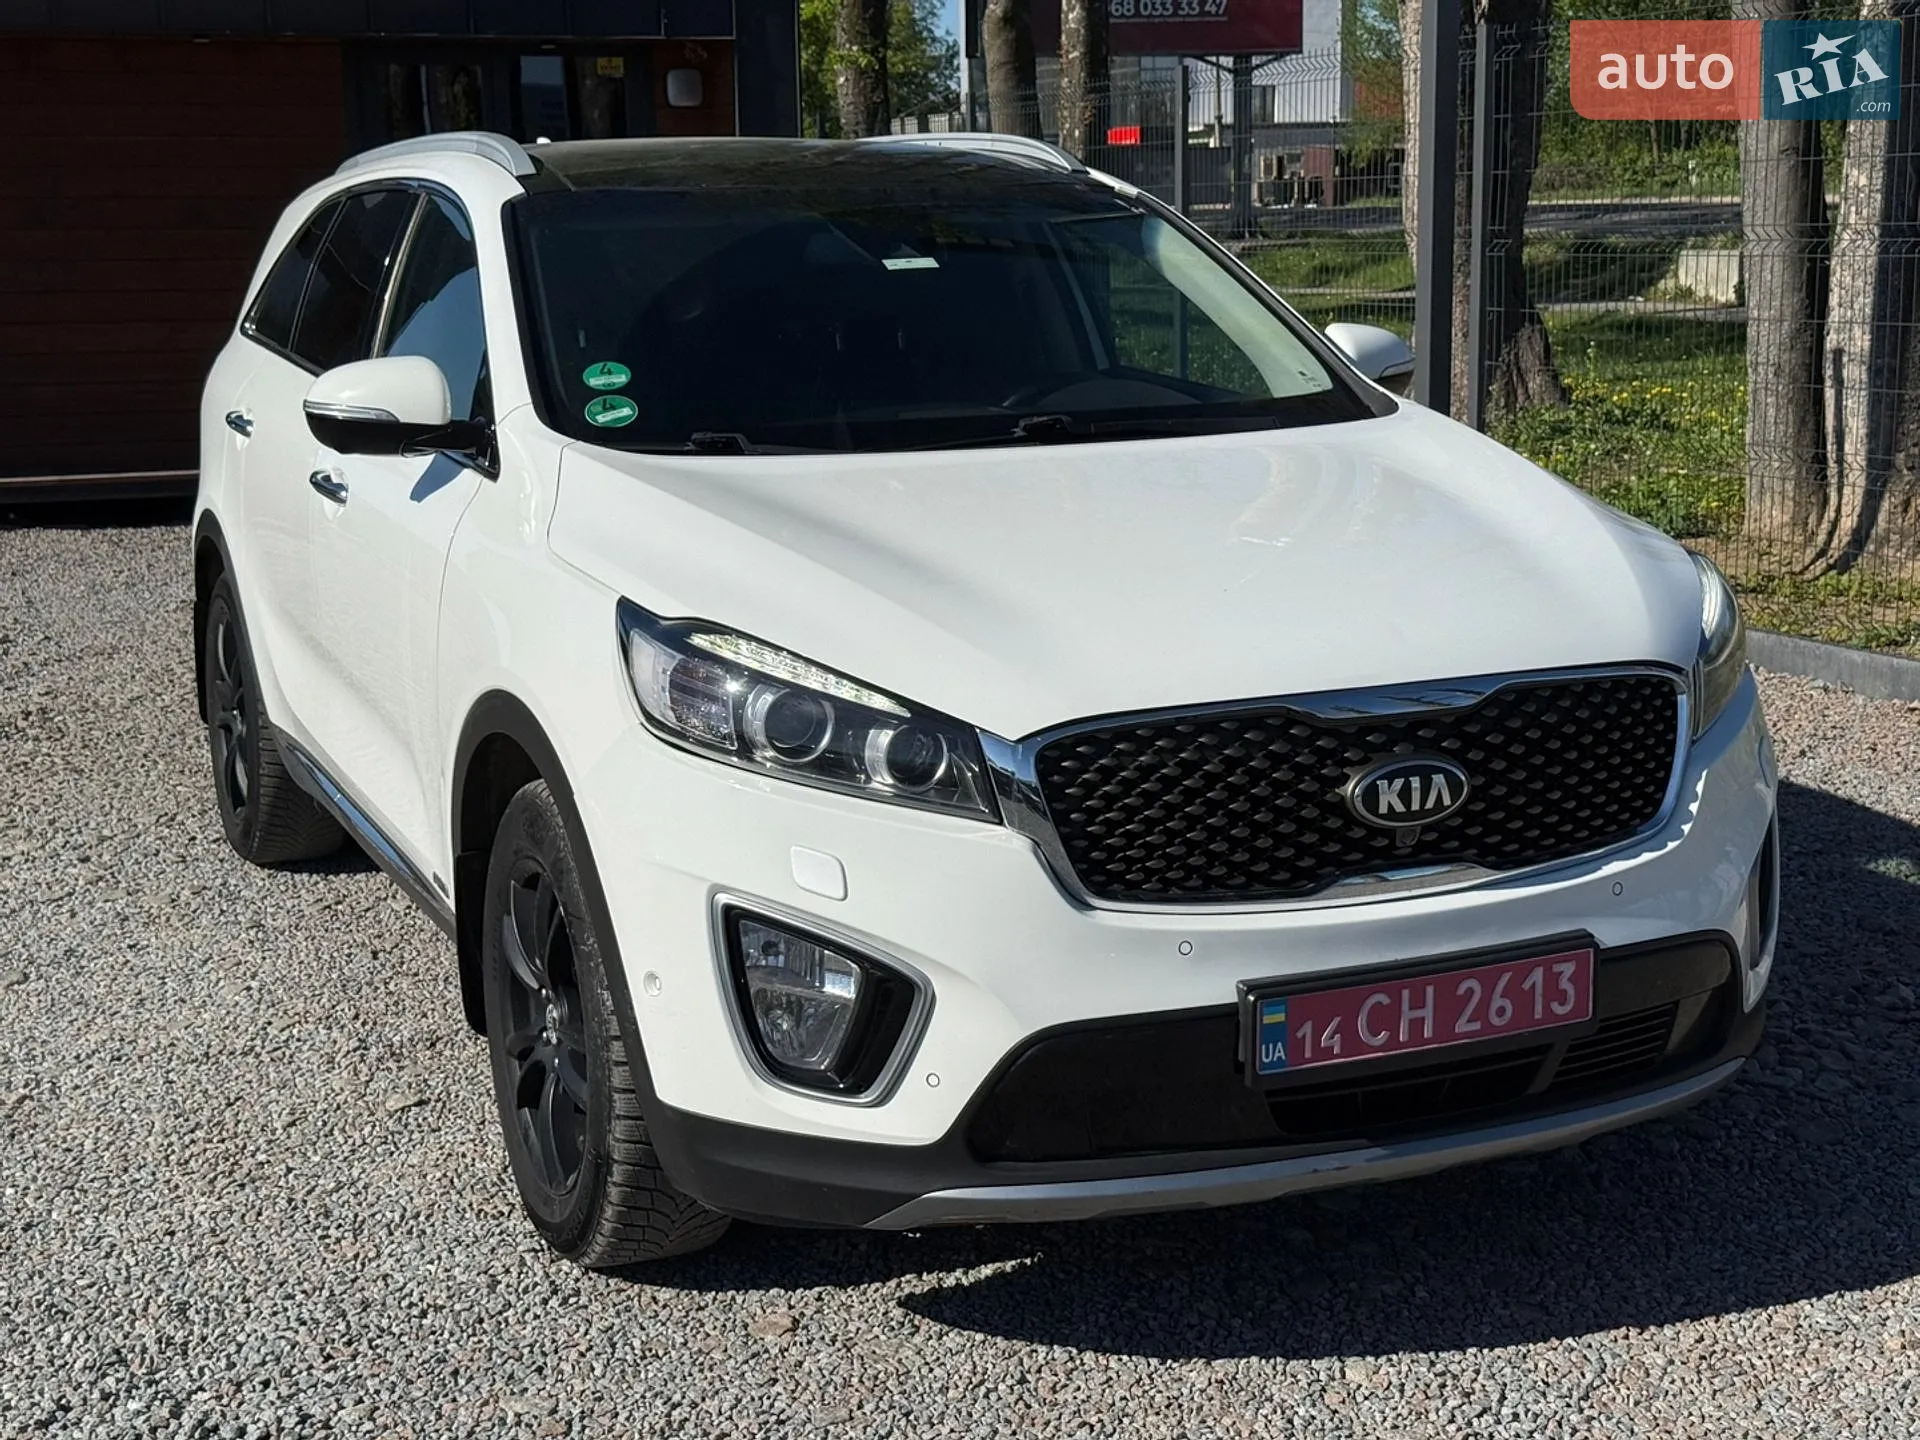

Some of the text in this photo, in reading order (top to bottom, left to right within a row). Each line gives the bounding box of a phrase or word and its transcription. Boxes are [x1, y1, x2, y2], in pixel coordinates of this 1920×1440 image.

[1140, 0, 1173, 16] 033
[1177, 0, 1200, 15] 33
[1204, 0, 1228, 15] 47
[1376, 774, 1452, 814] KIA
[1296, 960, 1577, 1059] 14 CH 2613
[1261, 1039, 1286, 1063] UA
